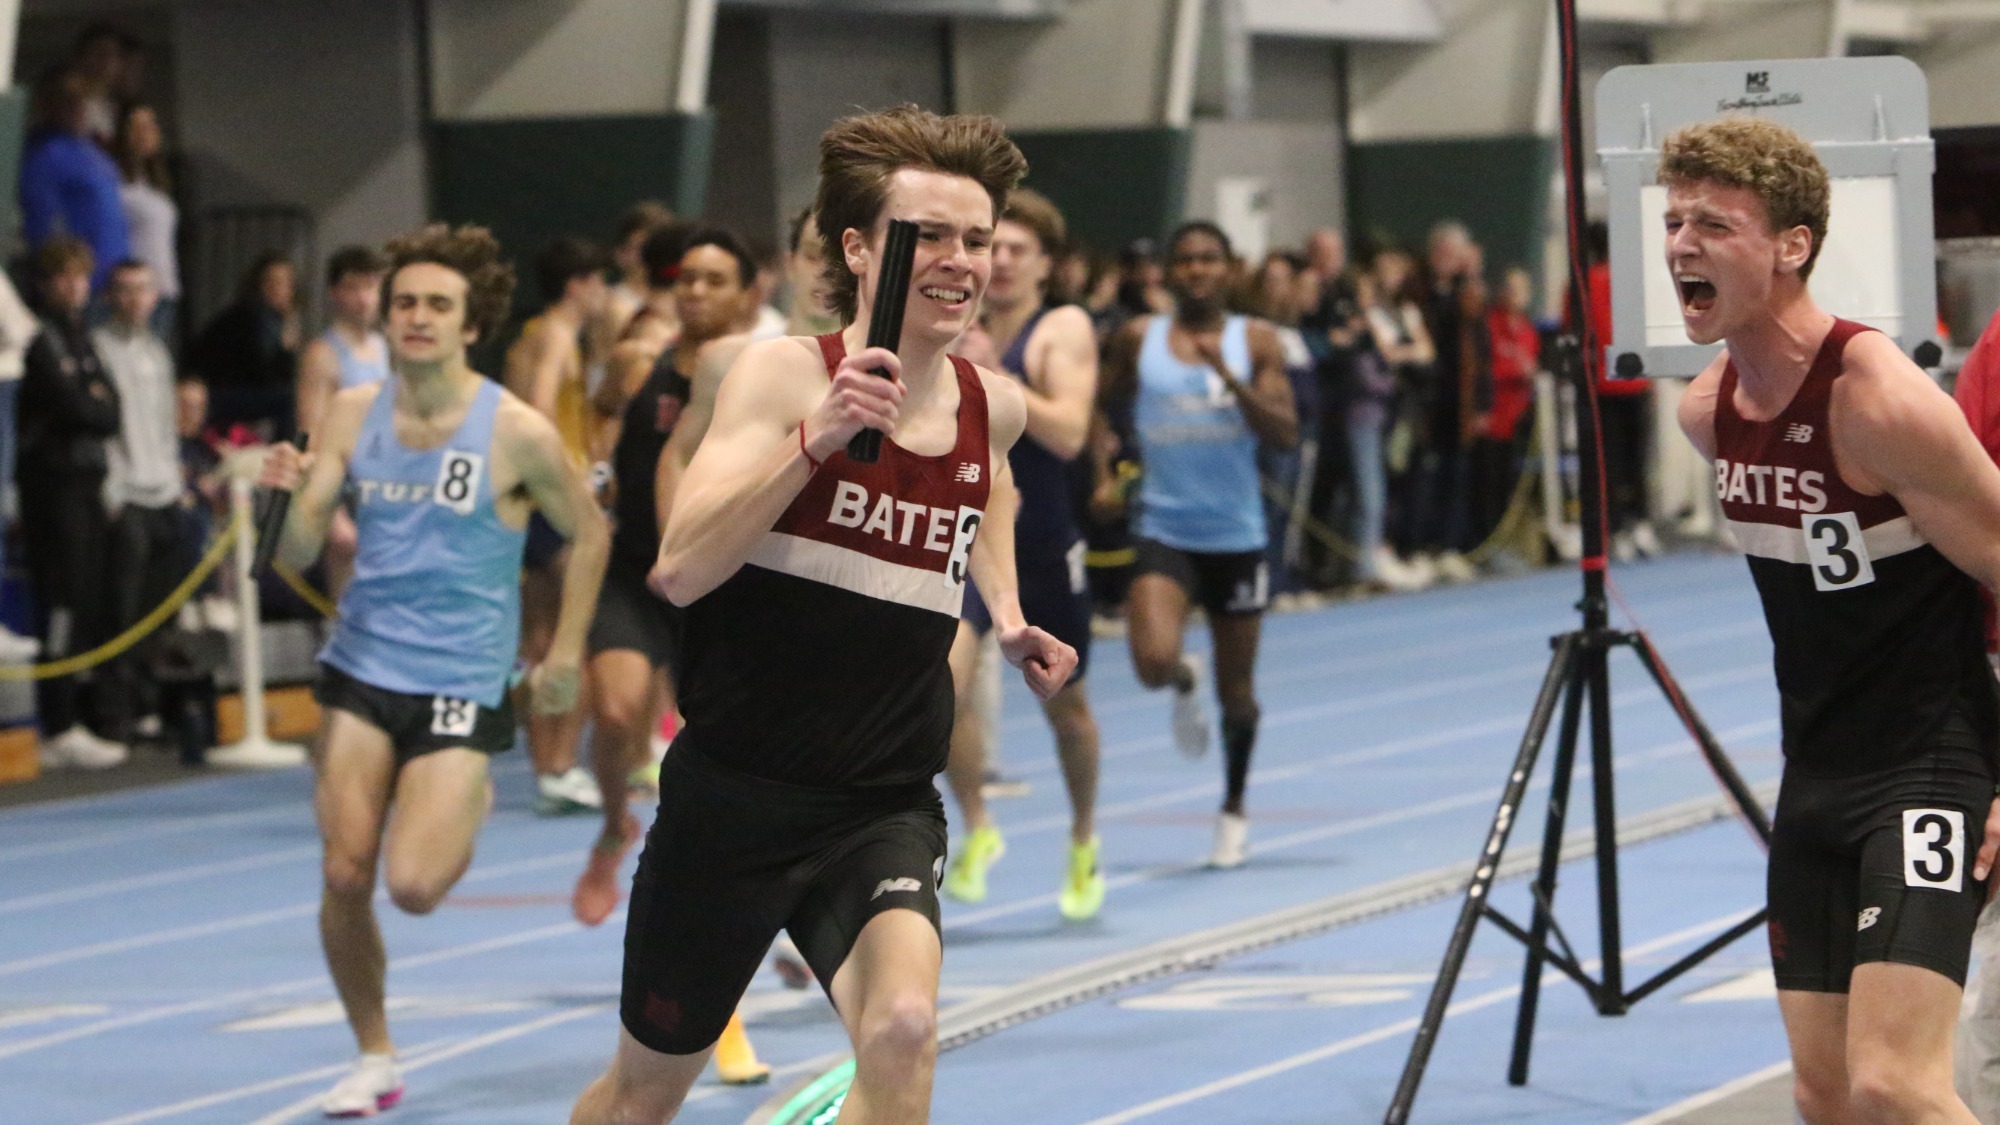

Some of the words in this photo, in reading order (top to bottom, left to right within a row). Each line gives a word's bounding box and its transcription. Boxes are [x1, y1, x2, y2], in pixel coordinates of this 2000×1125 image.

[359, 480, 434, 505] TUF
[444, 458, 472, 501] 8
[1714, 458, 1828, 513] BATES
[827, 479, 956, 553] BATE
[952, 514, 981, 585] 3
[1811, 518, 1860, 585] 3
[1912, 813, 1954, 883] 3
